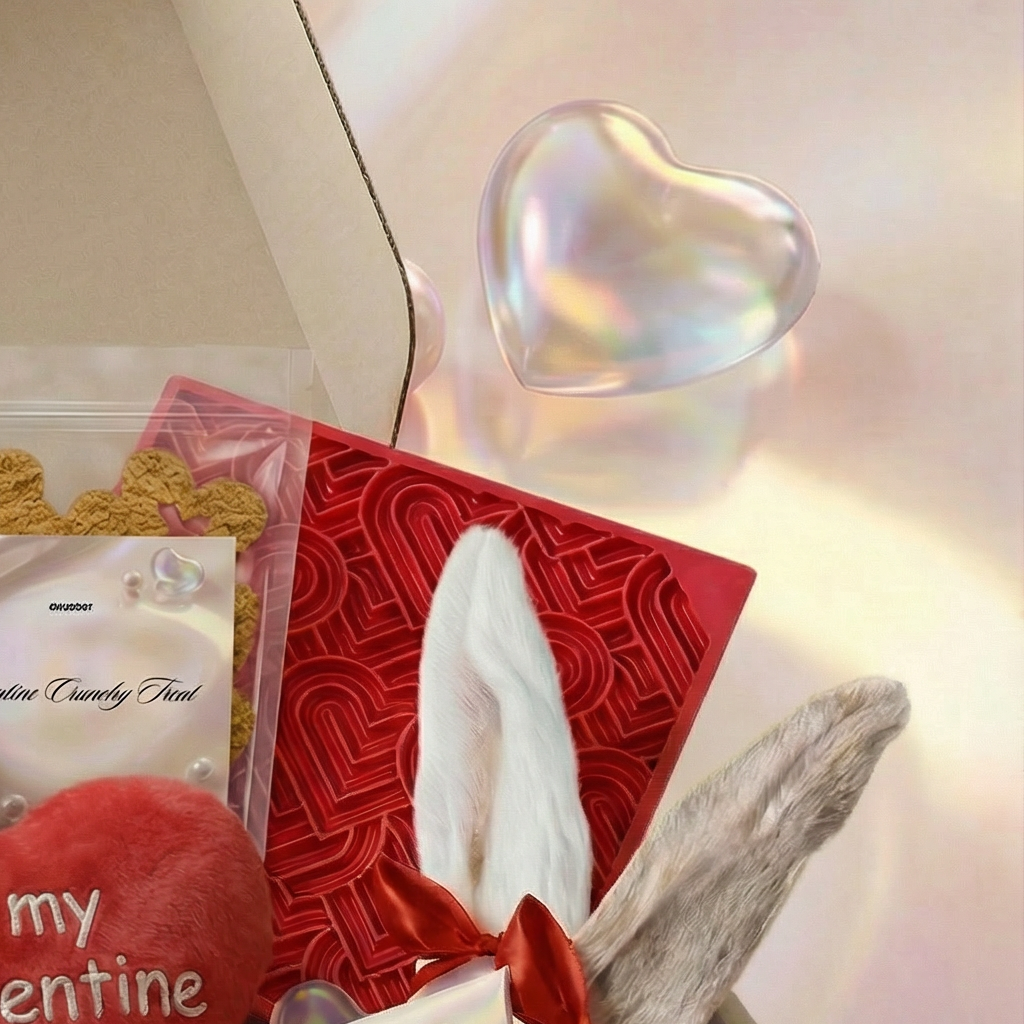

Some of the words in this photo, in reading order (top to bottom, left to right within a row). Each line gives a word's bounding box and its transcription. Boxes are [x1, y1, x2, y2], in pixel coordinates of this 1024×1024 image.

[44, 677, 134, 711] Crunchy
[136, 677, 204, 704] Treat
[6, 888, 101, 949] my
